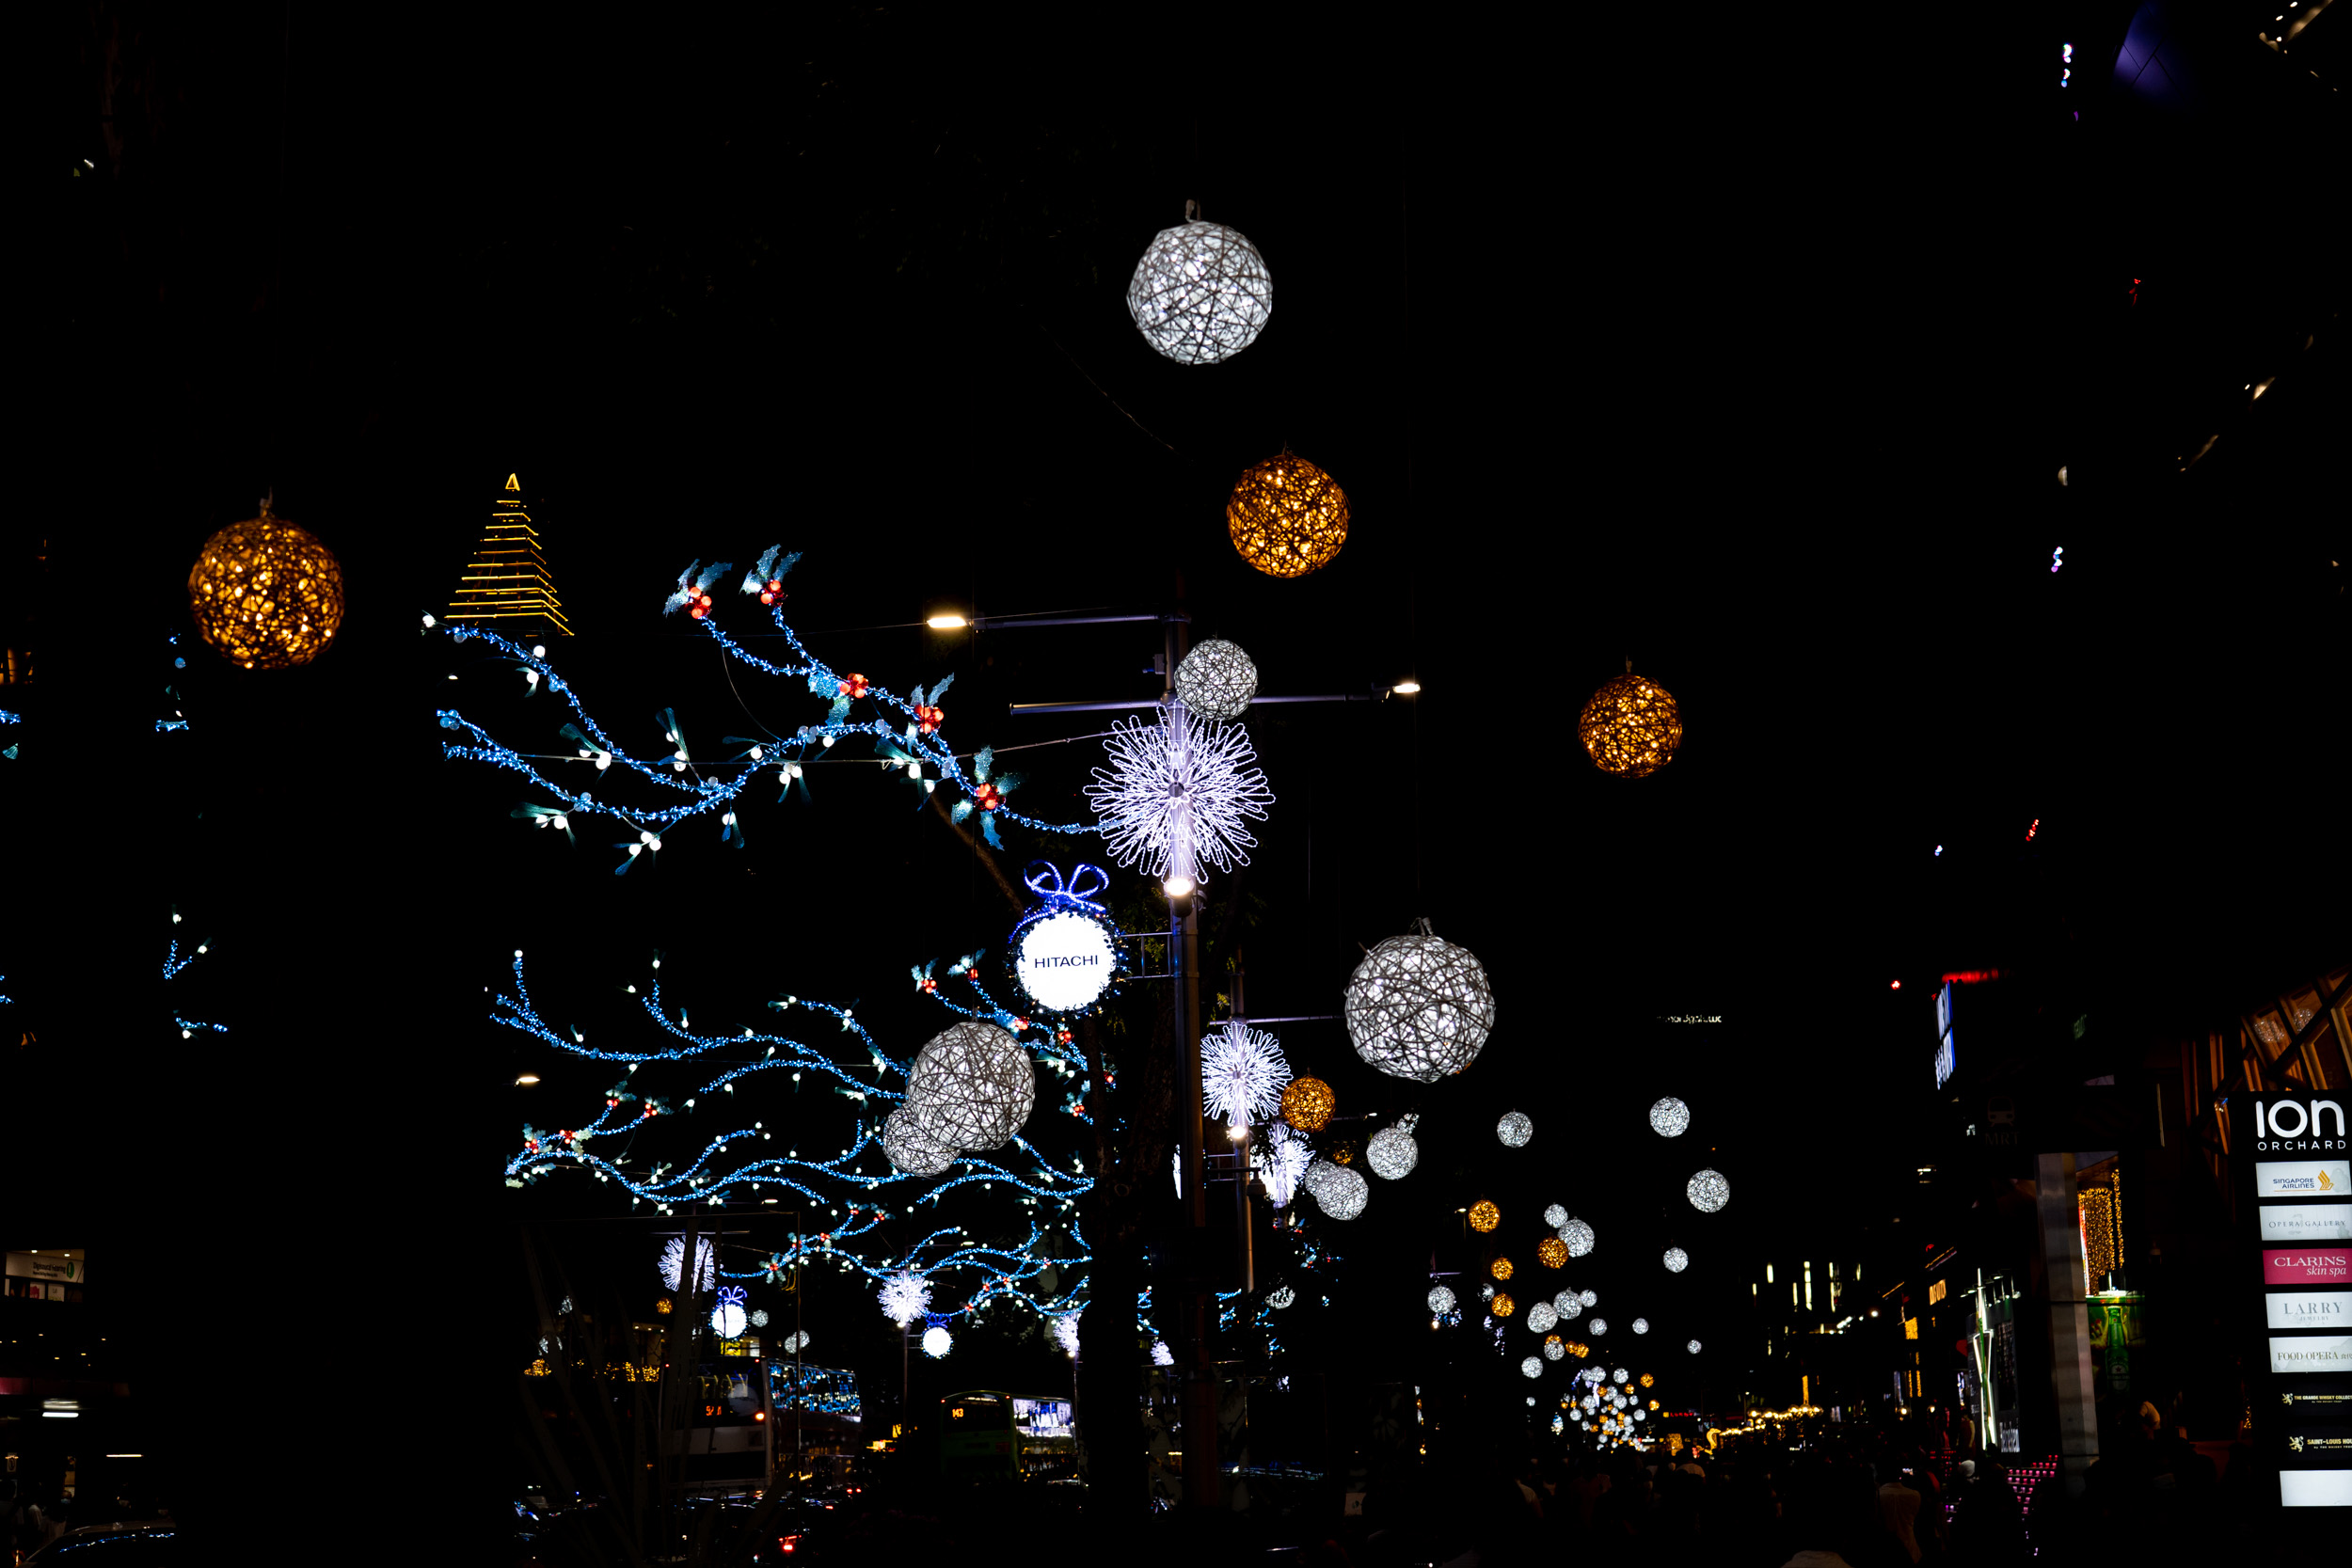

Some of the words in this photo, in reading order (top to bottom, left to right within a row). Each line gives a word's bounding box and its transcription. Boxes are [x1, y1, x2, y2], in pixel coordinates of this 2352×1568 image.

[1034, 955, 1098, 968] HITACHI
[2257, 1140, 2346, 1151] ORCHARD
[2274, 1256, 2346, 1267] CLARINS
[2306, 1265, 2328, 1275] skin
[2328, 1267, 2347, 1277] spa
[2283, 1302, 2343, 1314] LARRY
[2278, 1352, 2303, 1360] FOOD
[2305, 1351, 2339, 1360] OPERA
[952, 1408, 964, 1418] 143
